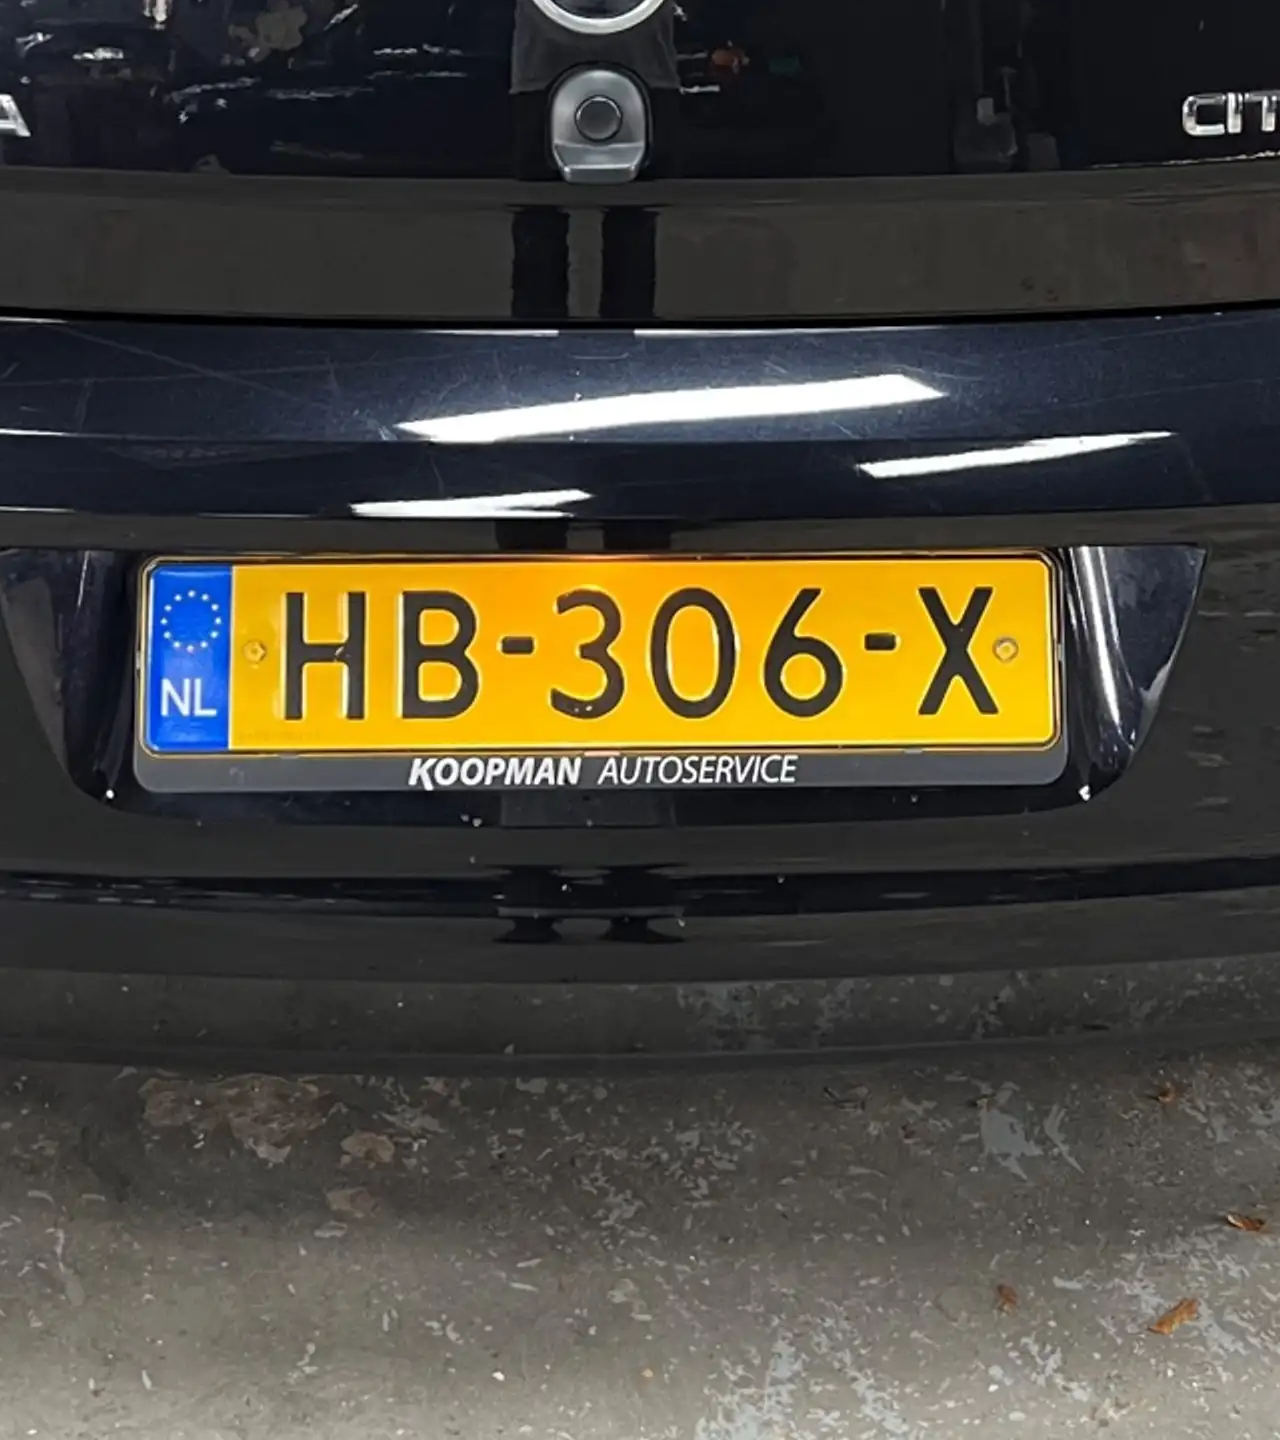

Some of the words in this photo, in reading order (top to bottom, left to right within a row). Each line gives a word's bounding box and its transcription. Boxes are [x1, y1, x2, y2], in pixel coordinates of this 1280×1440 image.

[283, 585, 1002, 722] HB-306-X
[159, 678, 219, 717] NL
[408, 758, 582, 791] KOOPMAN
[597, 754, 799, 785] AUTOSERVICE
